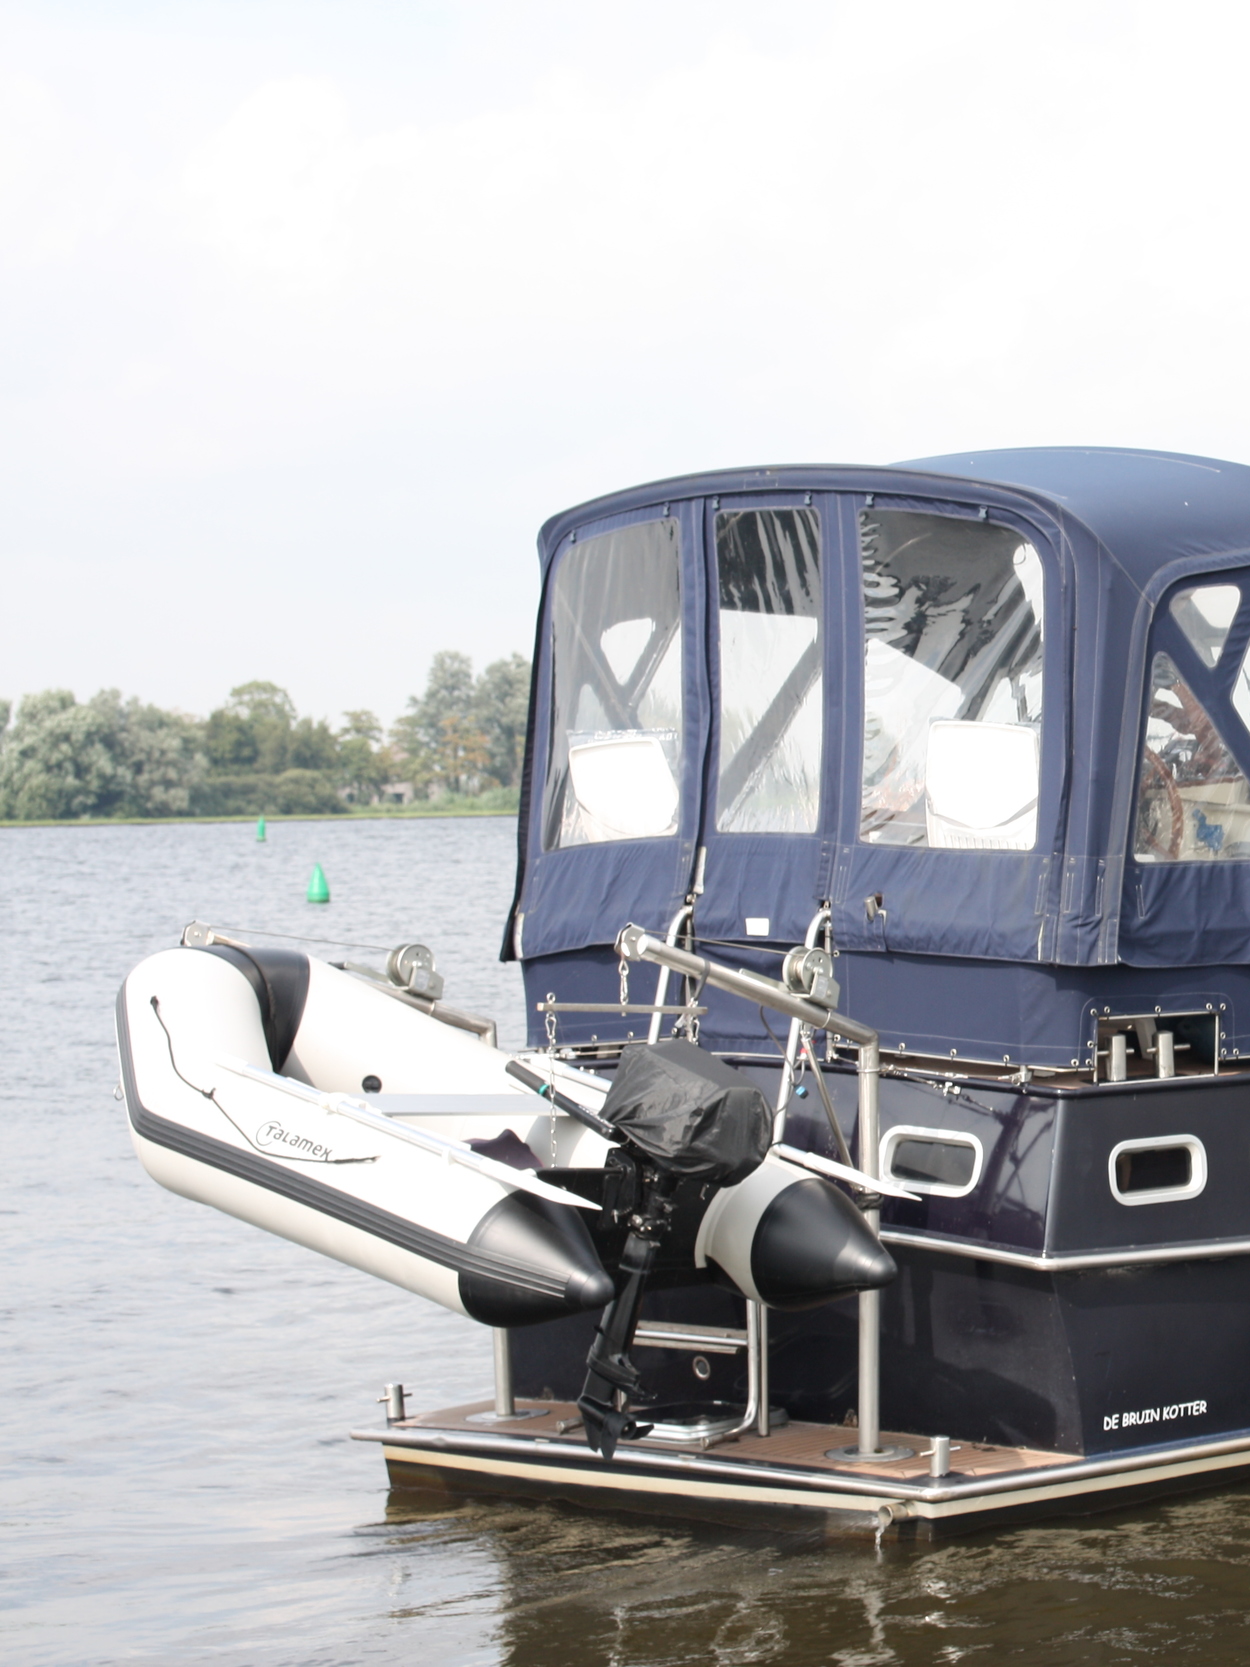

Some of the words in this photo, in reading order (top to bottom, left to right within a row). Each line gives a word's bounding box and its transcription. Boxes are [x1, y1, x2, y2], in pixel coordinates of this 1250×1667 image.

[1103, 1414, 1119, 1431] DE
[1122, 1408, 1160, 1427] BRUIN
[1162, 1400, 1207, 1420] KOTTER
